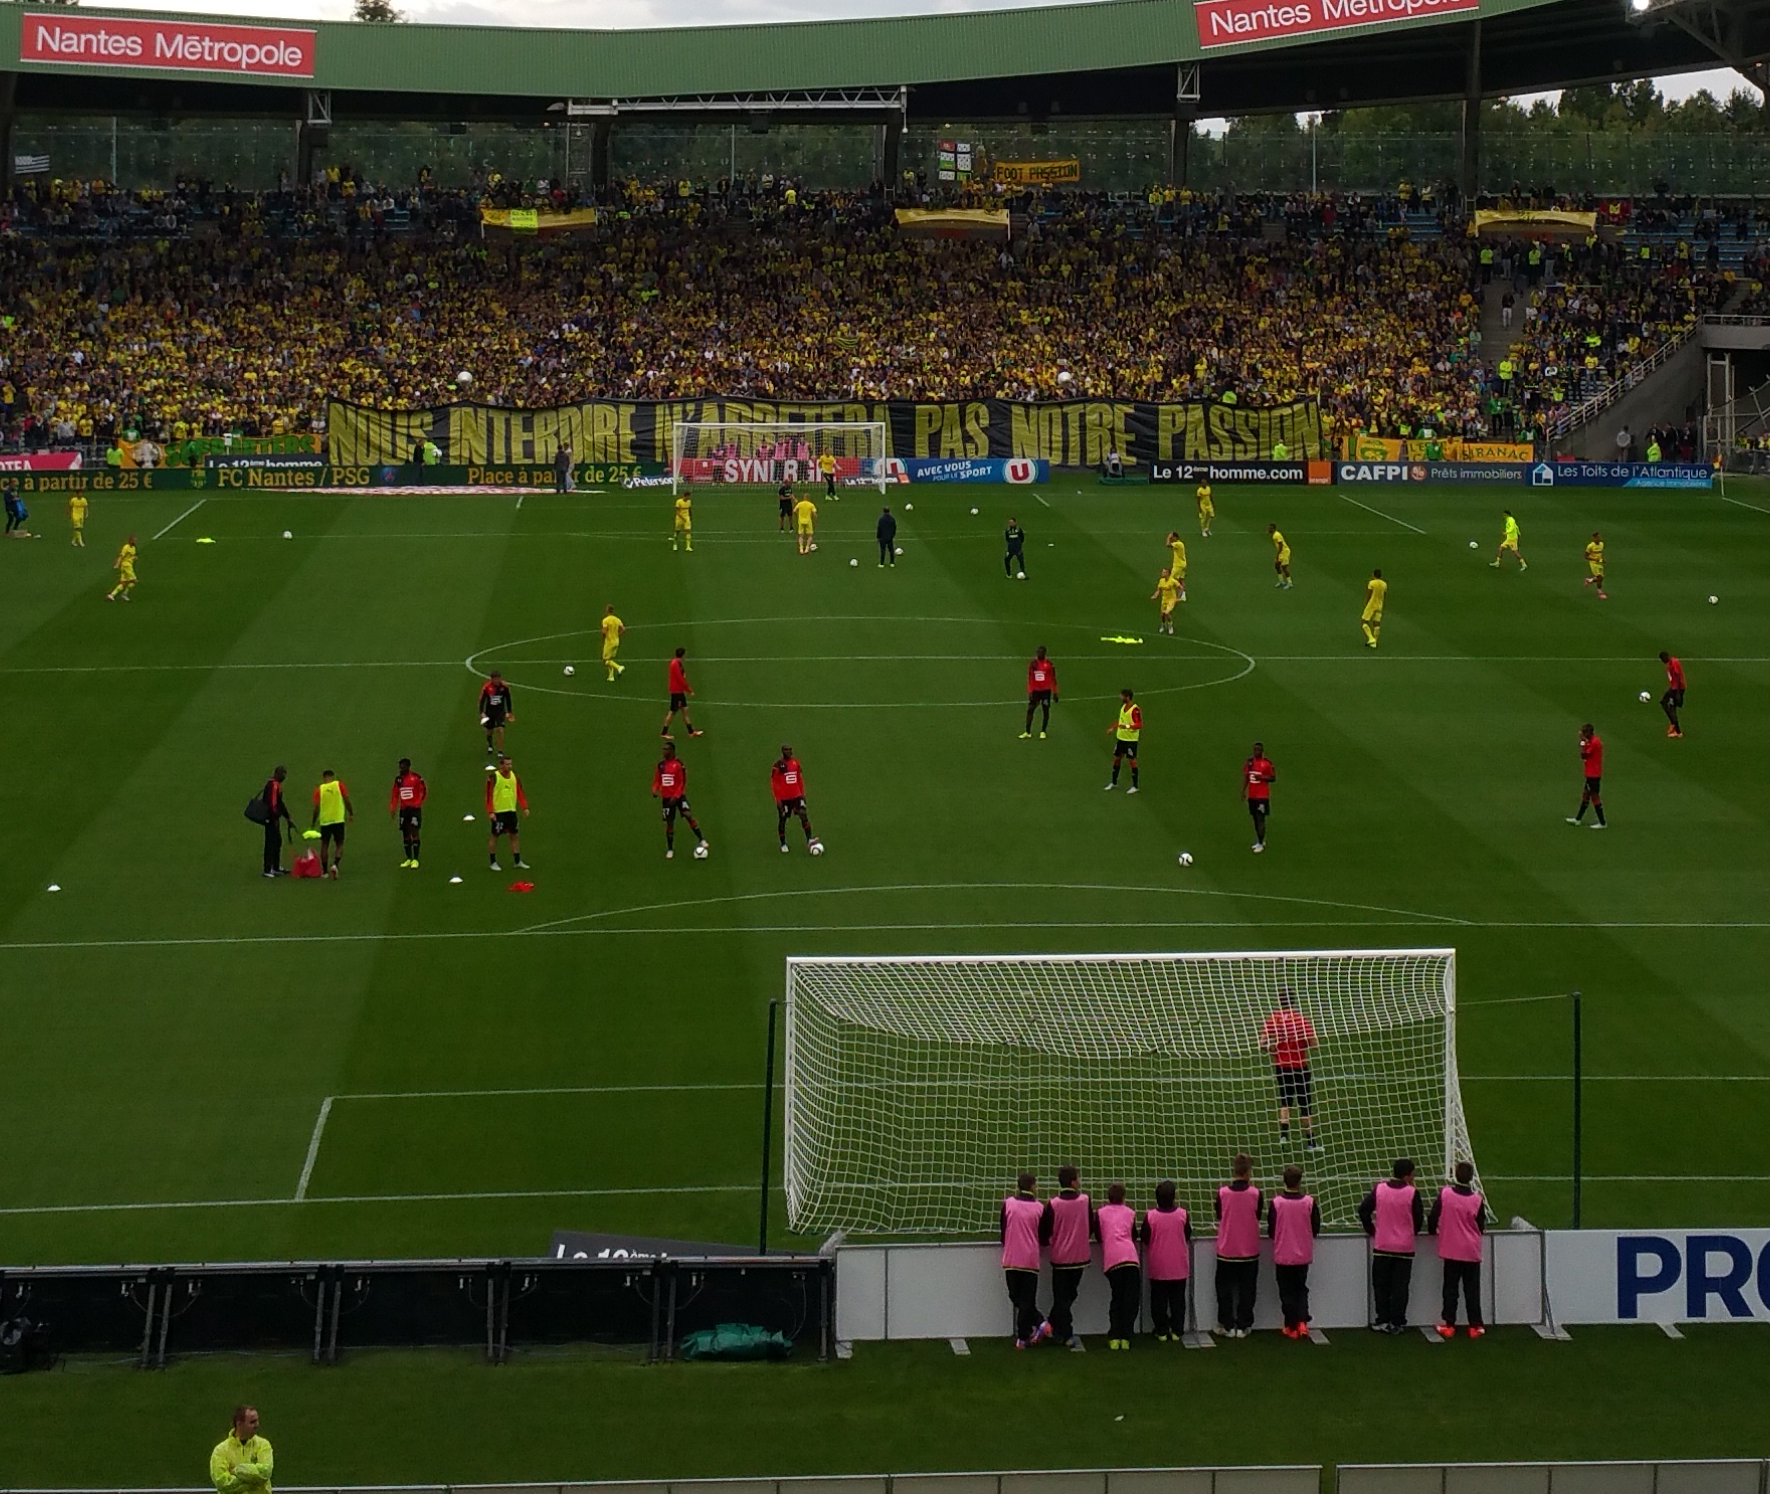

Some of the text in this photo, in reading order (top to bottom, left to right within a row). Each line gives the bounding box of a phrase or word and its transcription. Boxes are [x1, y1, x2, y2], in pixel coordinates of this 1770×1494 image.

[1210, 4, 1312, 37] Nantes
[36, 25, 143, 56] Nantes
[996, 164, 1077, 180] FOOT PASSION
[329, 402, 434, 466] NOUS
[448, 403, 637, 465] INTERDIRE
[914, 402, 991, 459] PAS
[1012, 404, 1137, 467] NOTRE
[1158, 399, 1319, 461] PASSION
[218, 471, 243, 489] FC
[247, 470, 315, 488] Nantes
[331, 466, 371, 485] PSG
[467, 466, 514, 485] Place
[517, 465, 529, 485] à
[584, 464, 604, 483] de
[608, 464, 629, 484] 25
[917, 460, 972, 478] AVEC VOUS
[960, 466, 993, 480] SPORT
[1153, 465, 1172, 479] Le
[1210, 464, 1305, 480] homme.com
[1340, 464, 1408, 481] CAFPI
[1431, 466, 1523, 480] Prêts immobiliers
[1558, 464, 1709, 482] Les Toits de l'Atlantique
[23, 473, 35, 490] à
[38, 473, 89, 491] partir
[91, 473, 113, 490] de
[117, 472, 140, 490] 25
[141, 472, 153, 489] €
